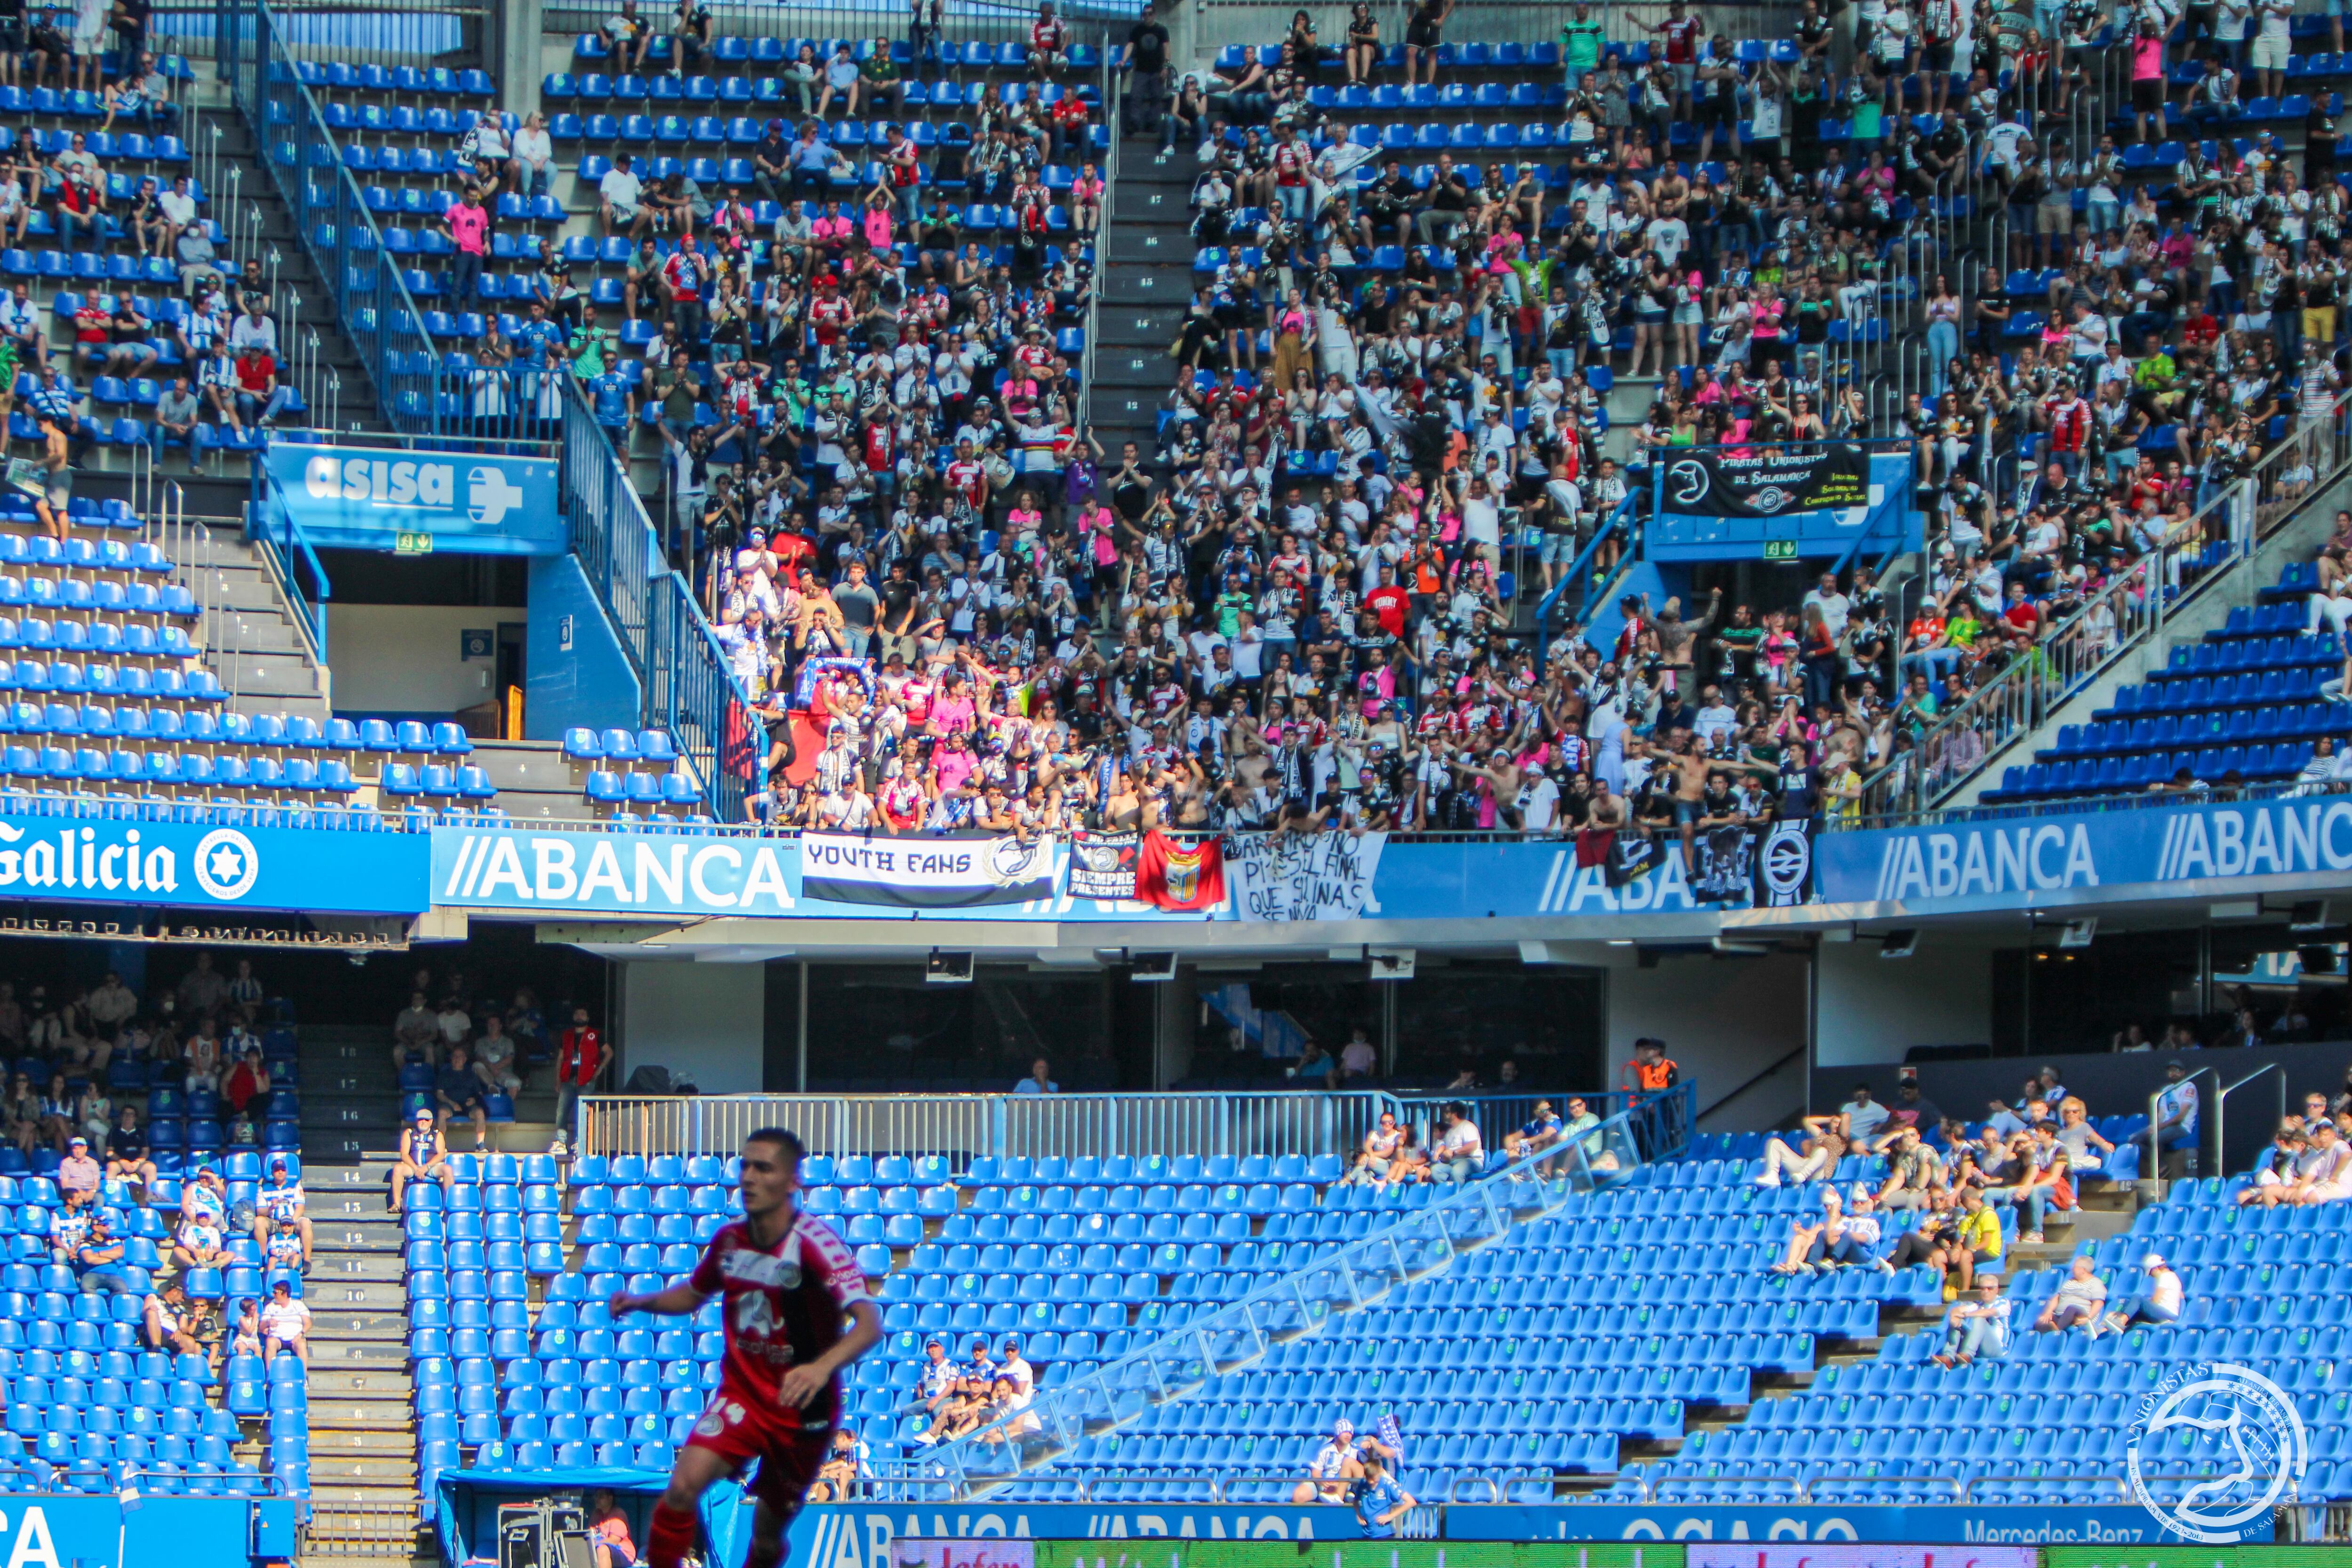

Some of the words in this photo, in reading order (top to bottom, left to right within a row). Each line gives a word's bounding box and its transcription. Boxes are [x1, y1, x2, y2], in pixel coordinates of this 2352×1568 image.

[305, 456, 453, 505] asisa
[1375, 596, 1397, 608] TOMMY
[808, 843, 895, 871] YOUTH
[907, 854, 972, 873] FANS
[1897, 824, 2098, 899] ABANCA
[479, 837, 795, 909] ABANCA
[1072, 868, 1136, 885] SIEMPRE
[1071, 883, 1135, 895] PRESENTES
[344, 1172, 360, 1181] 14
[346, 1233, 362, 1243] 12
[347, 1261, 361, 1271] 11
[348, 1291, 364, 1301] 10
[353, 1321, 361, 1330] 9
